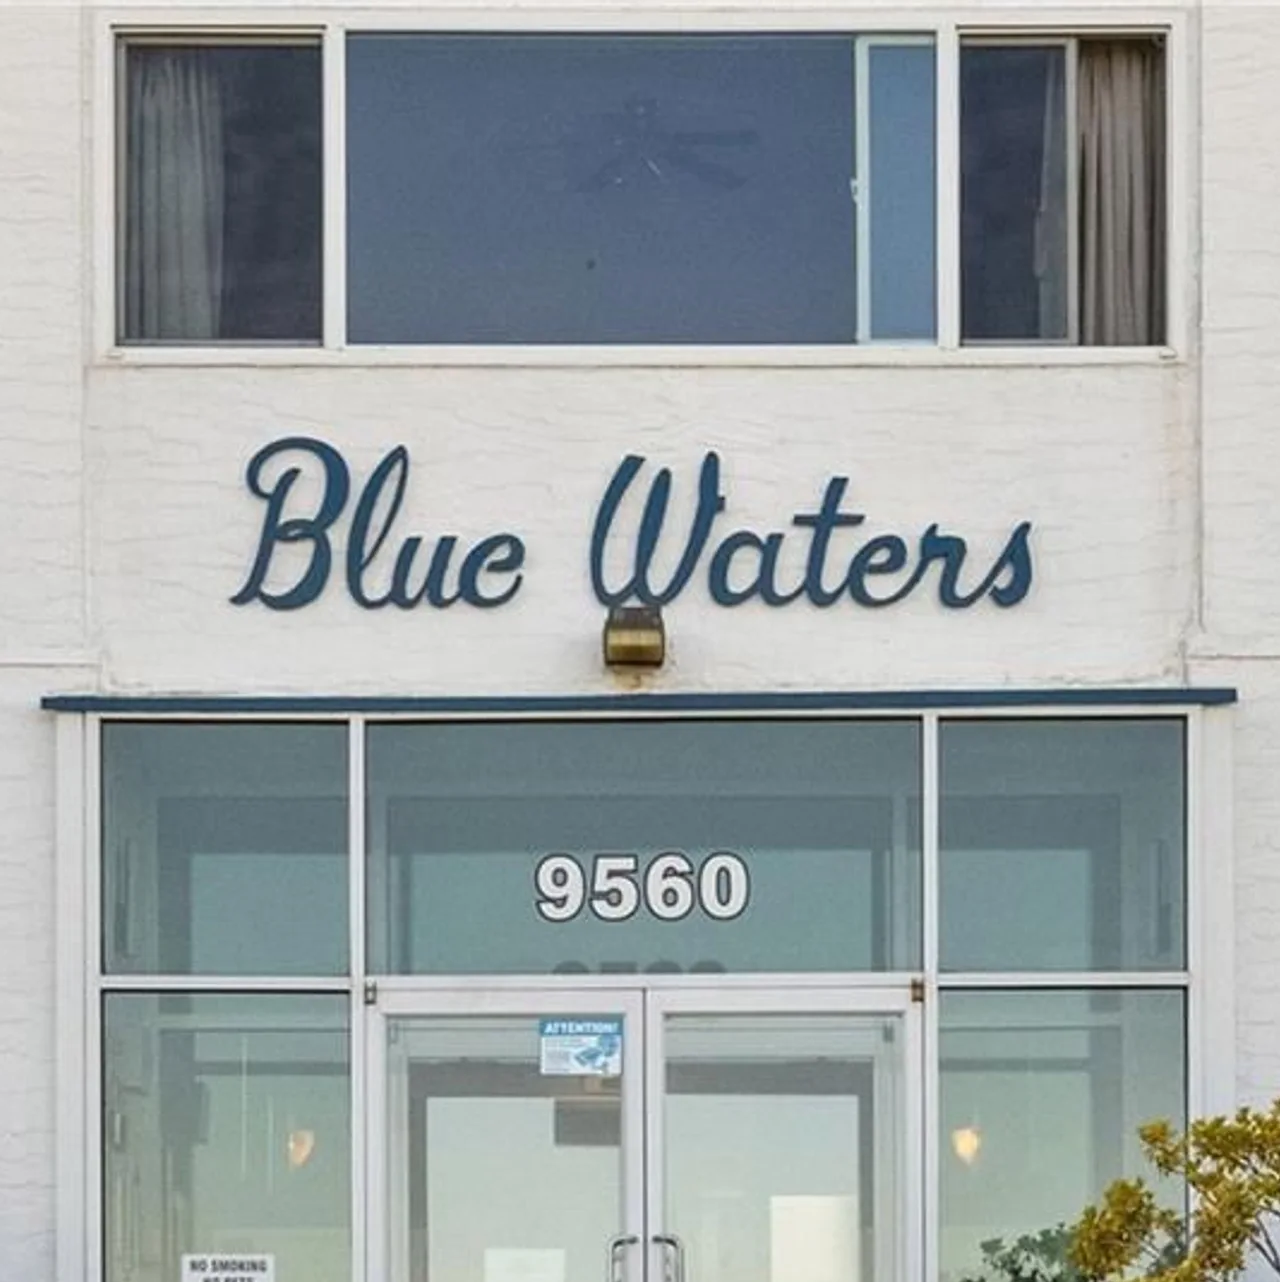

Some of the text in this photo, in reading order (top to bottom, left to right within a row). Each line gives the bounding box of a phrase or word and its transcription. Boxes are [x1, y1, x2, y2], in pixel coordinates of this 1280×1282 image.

[230, 436, 1032, 610] Blue Waters
[535, 851, 751, 922] 9560
[189, 1259, 268, 1273] NO SMOKING
